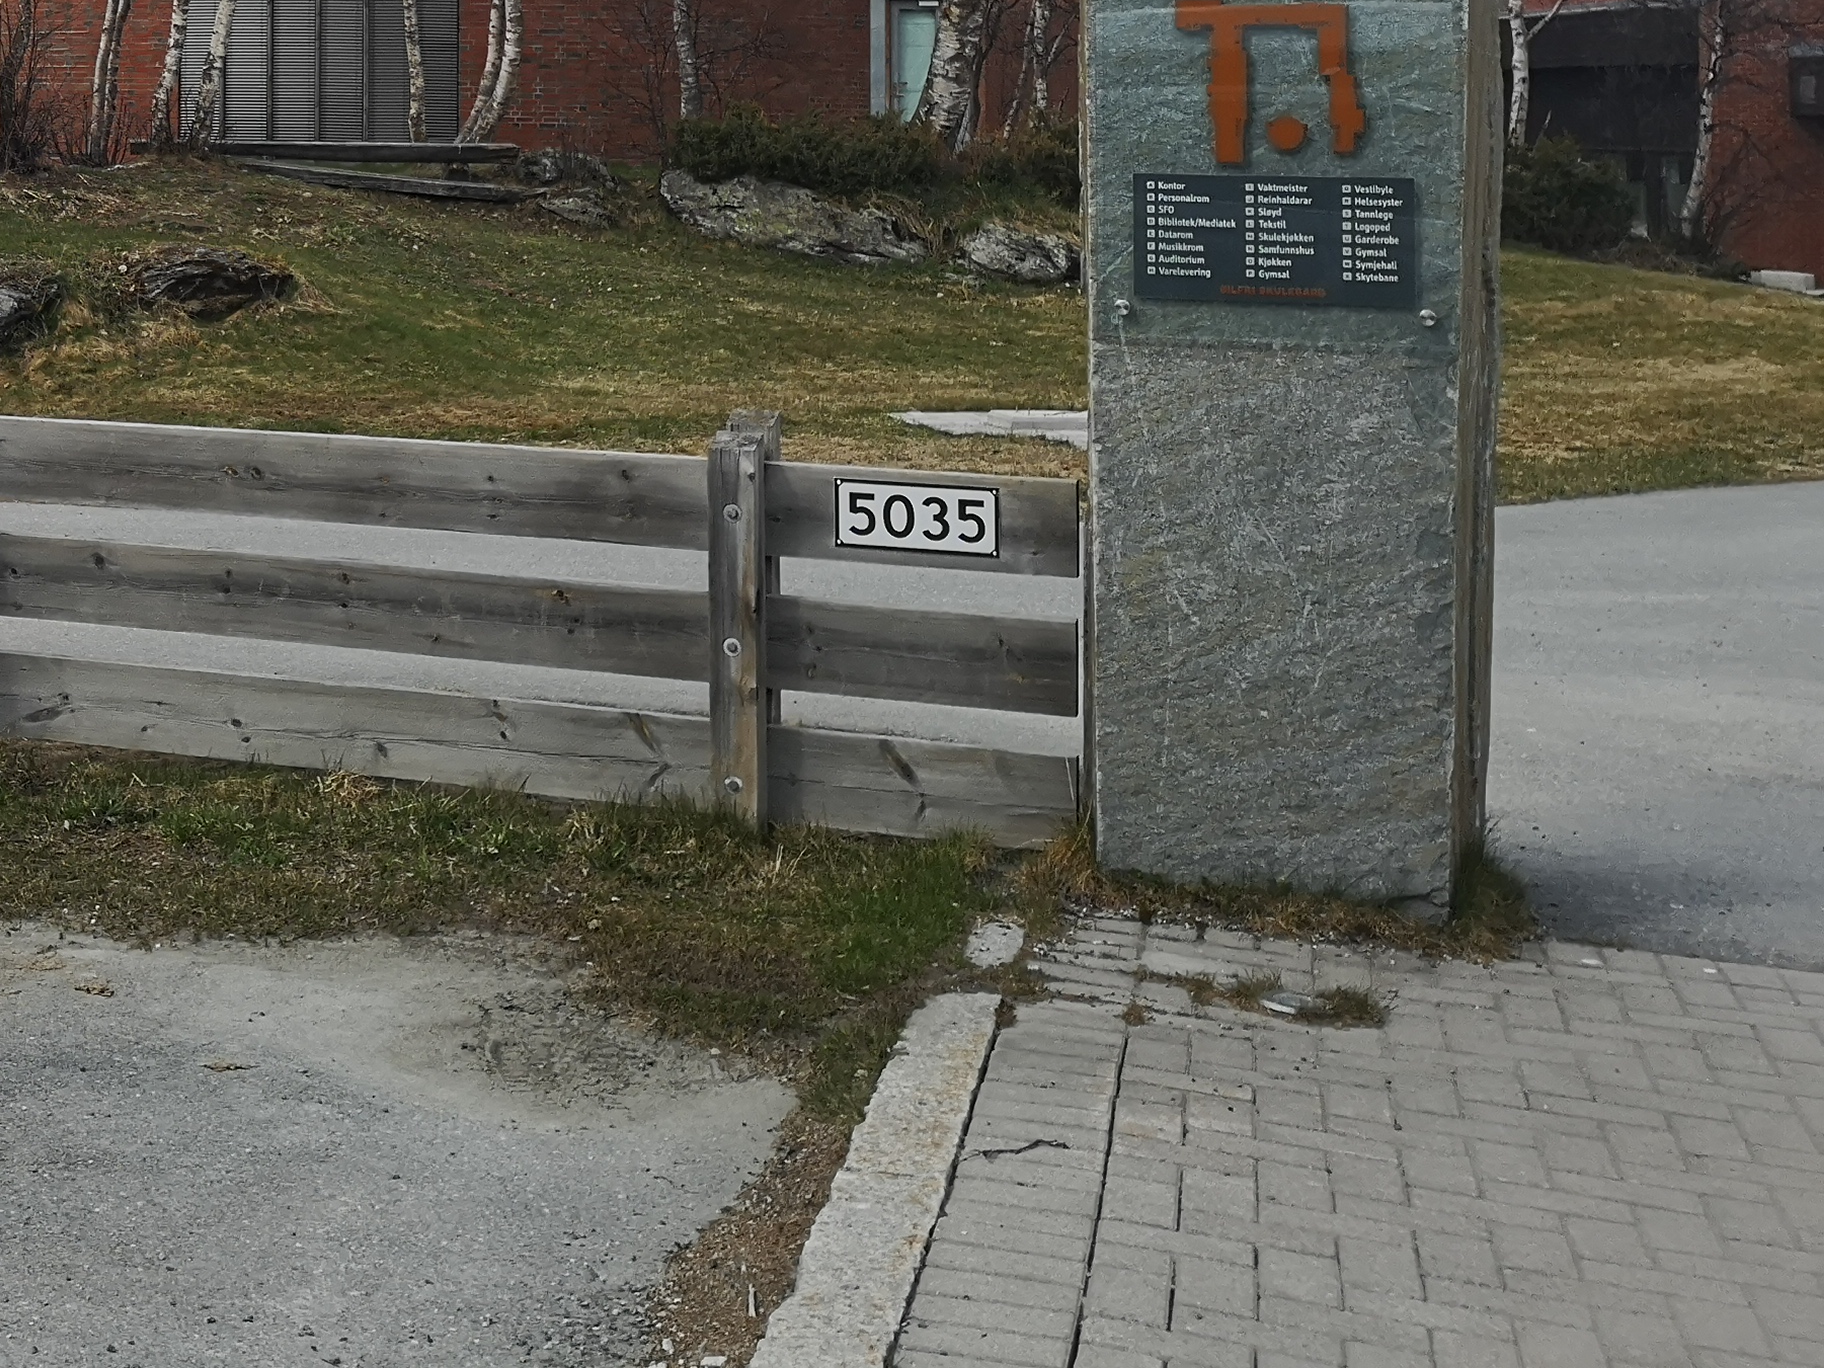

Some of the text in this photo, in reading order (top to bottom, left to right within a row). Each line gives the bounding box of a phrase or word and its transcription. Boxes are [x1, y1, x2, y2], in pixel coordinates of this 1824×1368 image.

[1158, 181, 1185, 189] Kontor
[1258, 183, 1308, 192] Vaktmeister
[1354, 185, 1393, 195] Vestibyle
[1158, 193, 1209, 202] Personalrom
[1258, 195, 1312, 204] Reinhaldarar
[1355, 197, 1403, 208] Helsesyster
[1158, 205, 1174, 214] SFO
[1355, 209, 1393, 221] Tannlege
[1158, 217, 1236, 228] Bibliotek/Mediatek
[1259, 220, 1286, 229] Tekstil
[1355, 222, 1390, 233] Logoped
[1159, 230, 1193, 239] Datarom
[1355, 235, 1399, 244] Garderobe
[1158, 242, 1203, 251] Musikkrom
[1259, 245, 1314, 255] Samfunnshus
[1356, 248, 1386, 258] Gymsal
[1159, 255, 1204, 264] Auditorium
[1159, 267, 1211, 278] Varelevering
[1259, 270, 1290, 279] Gymsal
[1356, 273, 1398, 282] Skytebane
[849, 492, 985, 543] 5035
